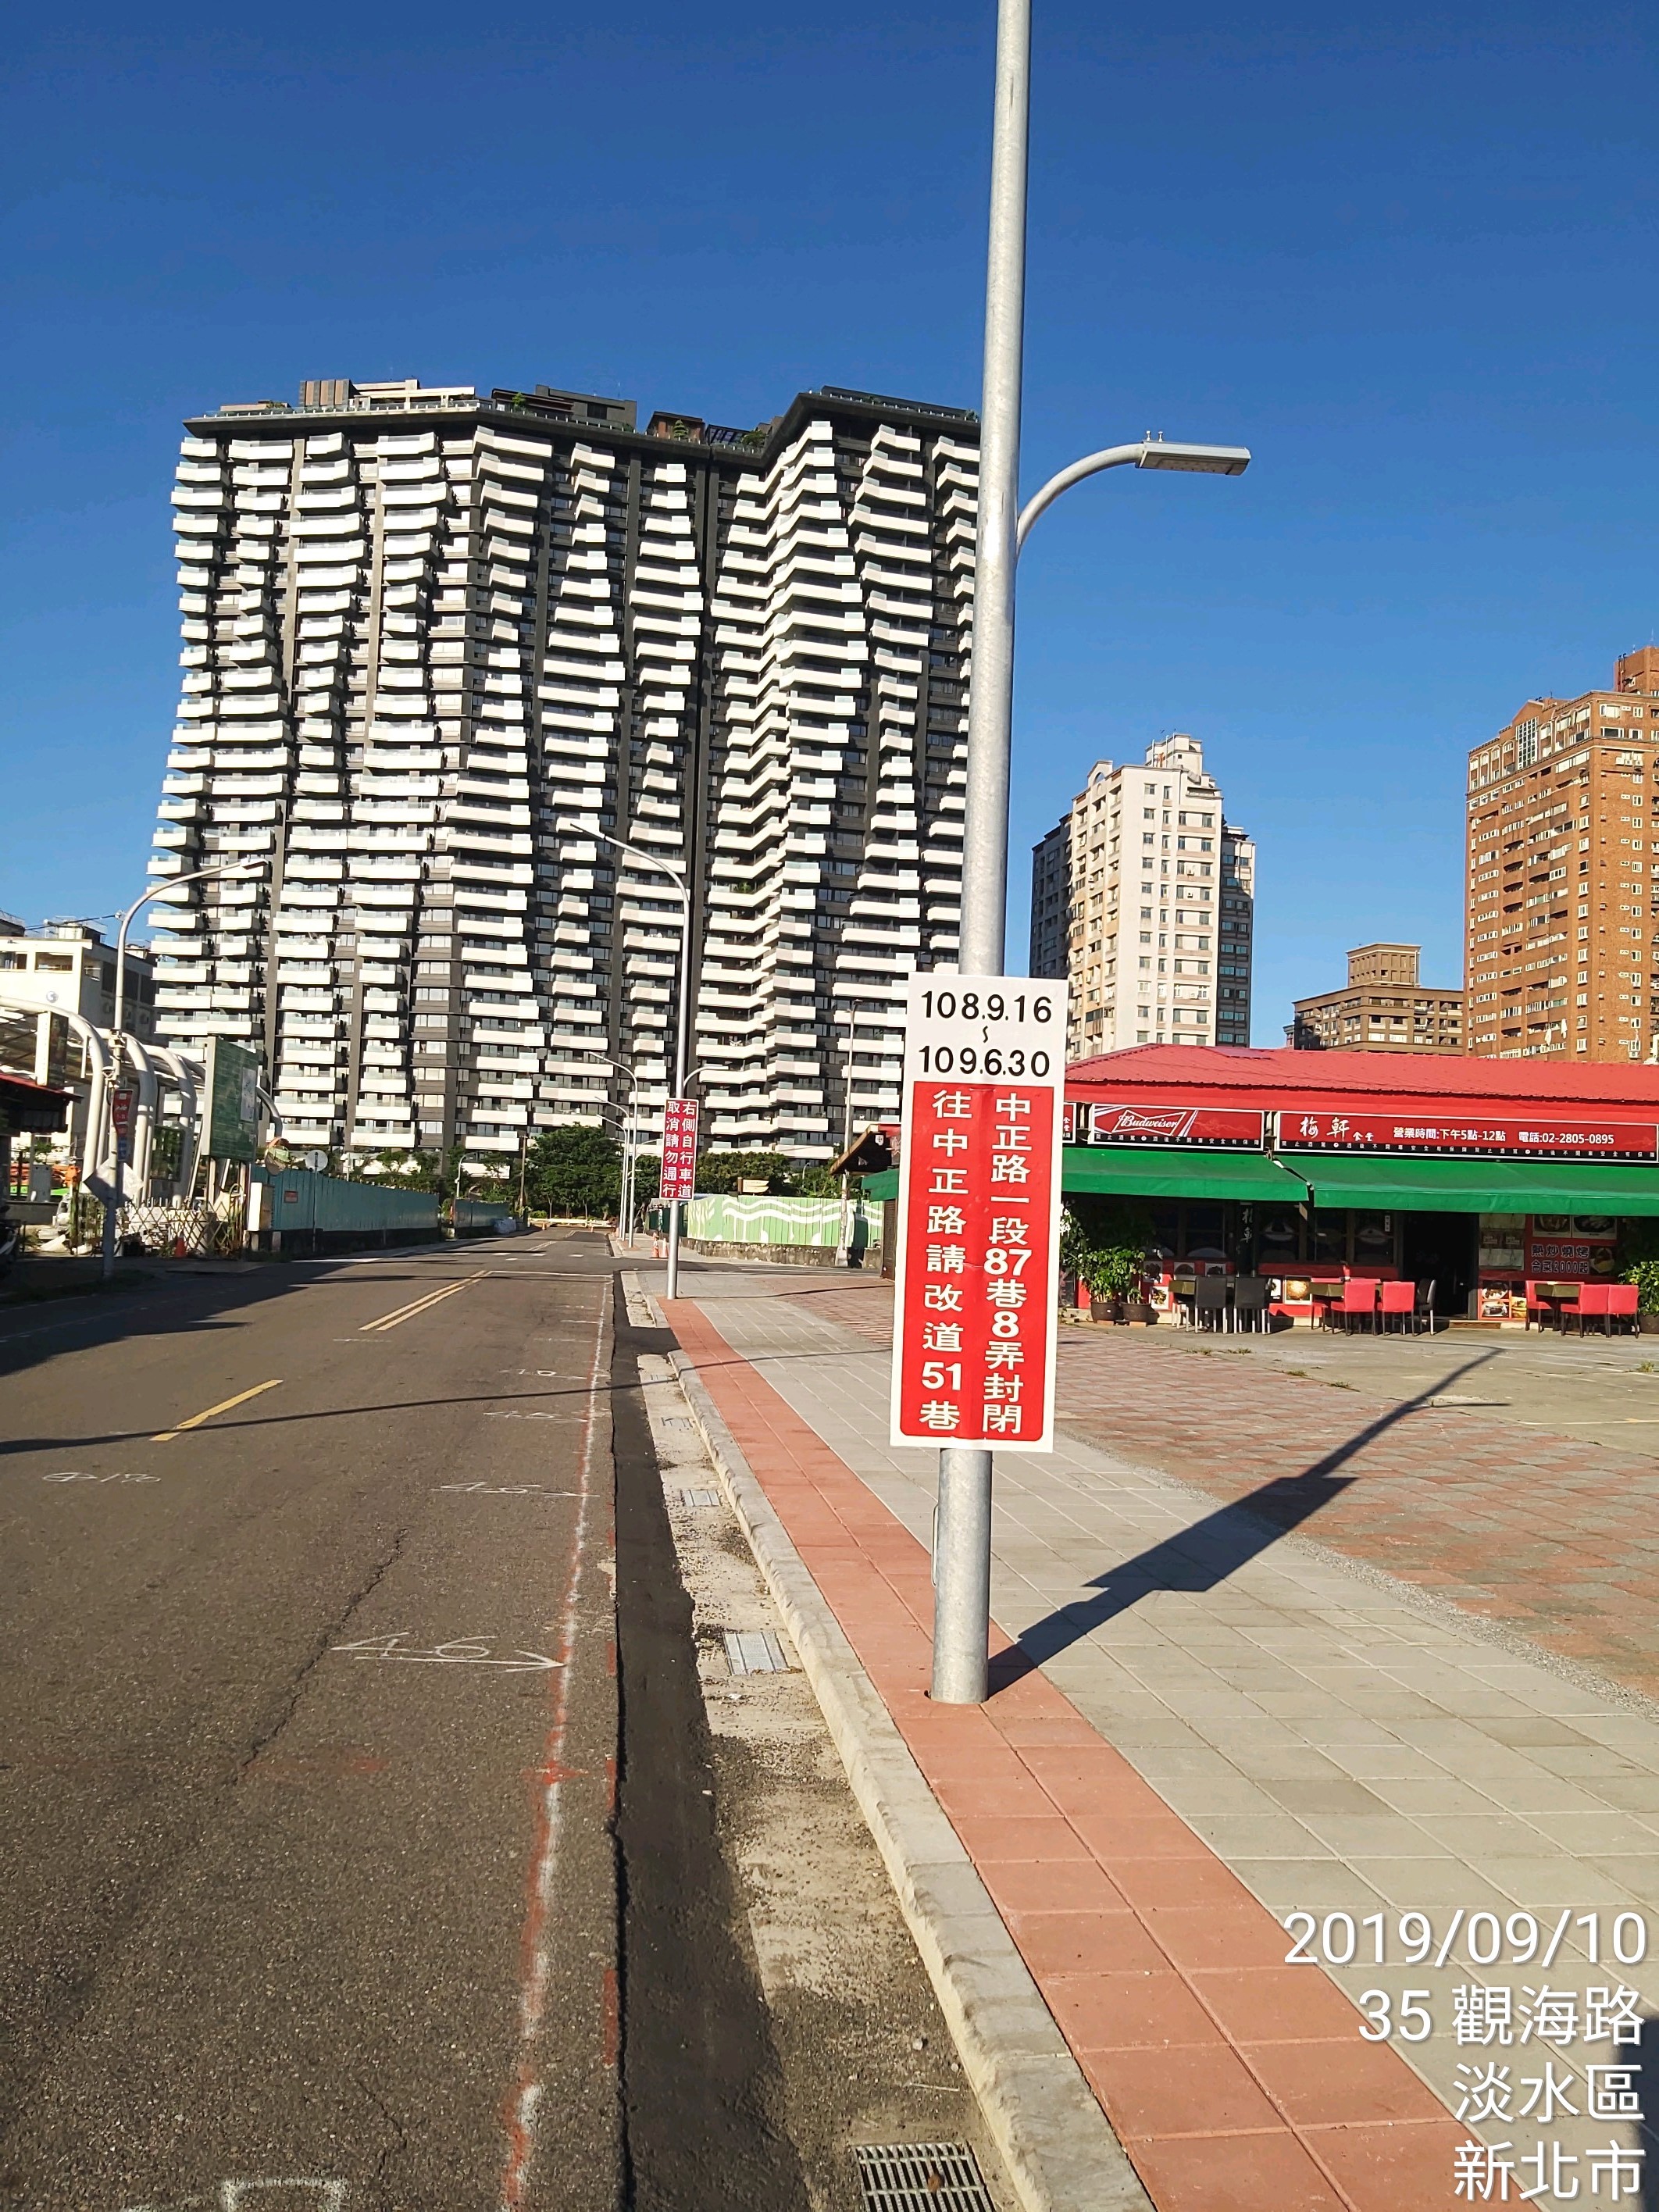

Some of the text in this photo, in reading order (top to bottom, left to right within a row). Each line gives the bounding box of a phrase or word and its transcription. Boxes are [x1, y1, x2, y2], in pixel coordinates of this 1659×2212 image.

[921, 990, 1052, 1023] 108.9.16
[919, 1045, 1050, 1077] 109.6.30
[662, 1101, 680, 1197] 取消請勿通行
[677, 1101, 697, 1198] 右側自行車道
[1118, 1114, 1179, 1129] Budweiser
[919, 1089, 972, 1431] 往中正路請改道51巷
[982, 1093, 1033, 1434] 中正路一段87巷8弄封閉
